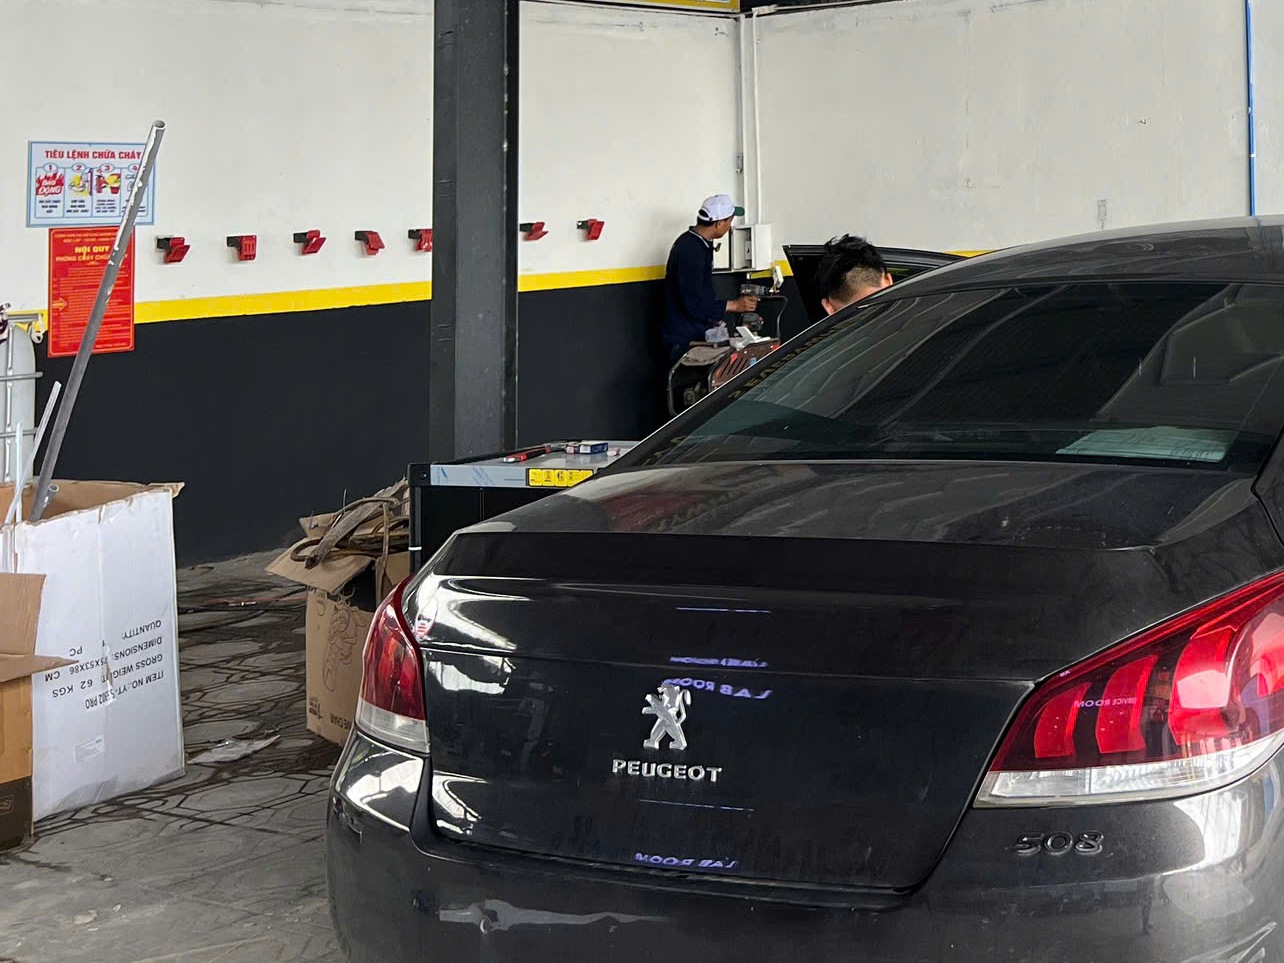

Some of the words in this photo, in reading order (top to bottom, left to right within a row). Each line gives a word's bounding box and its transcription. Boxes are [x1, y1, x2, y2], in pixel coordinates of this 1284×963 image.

[122, 619, 162, 640] QUANTITY:
[69, 646, 83, 656] PC
[112, 636, 163, 661] DIMENSIONS:
[135, 653, 163, 670] GROSS
[45, 670, 61, 682] CM
[101, 664, 134, 684] WEIGT:
[145, 670, 164, 683] ITEM
[52, 684, 74, 698] KGS
[80, 678, 93, 690] 62
[85, 697, 98, 710] PRO
[612, 758, 722, 782] PEUGEOT
[1014, 830, 1105, 855] 508
